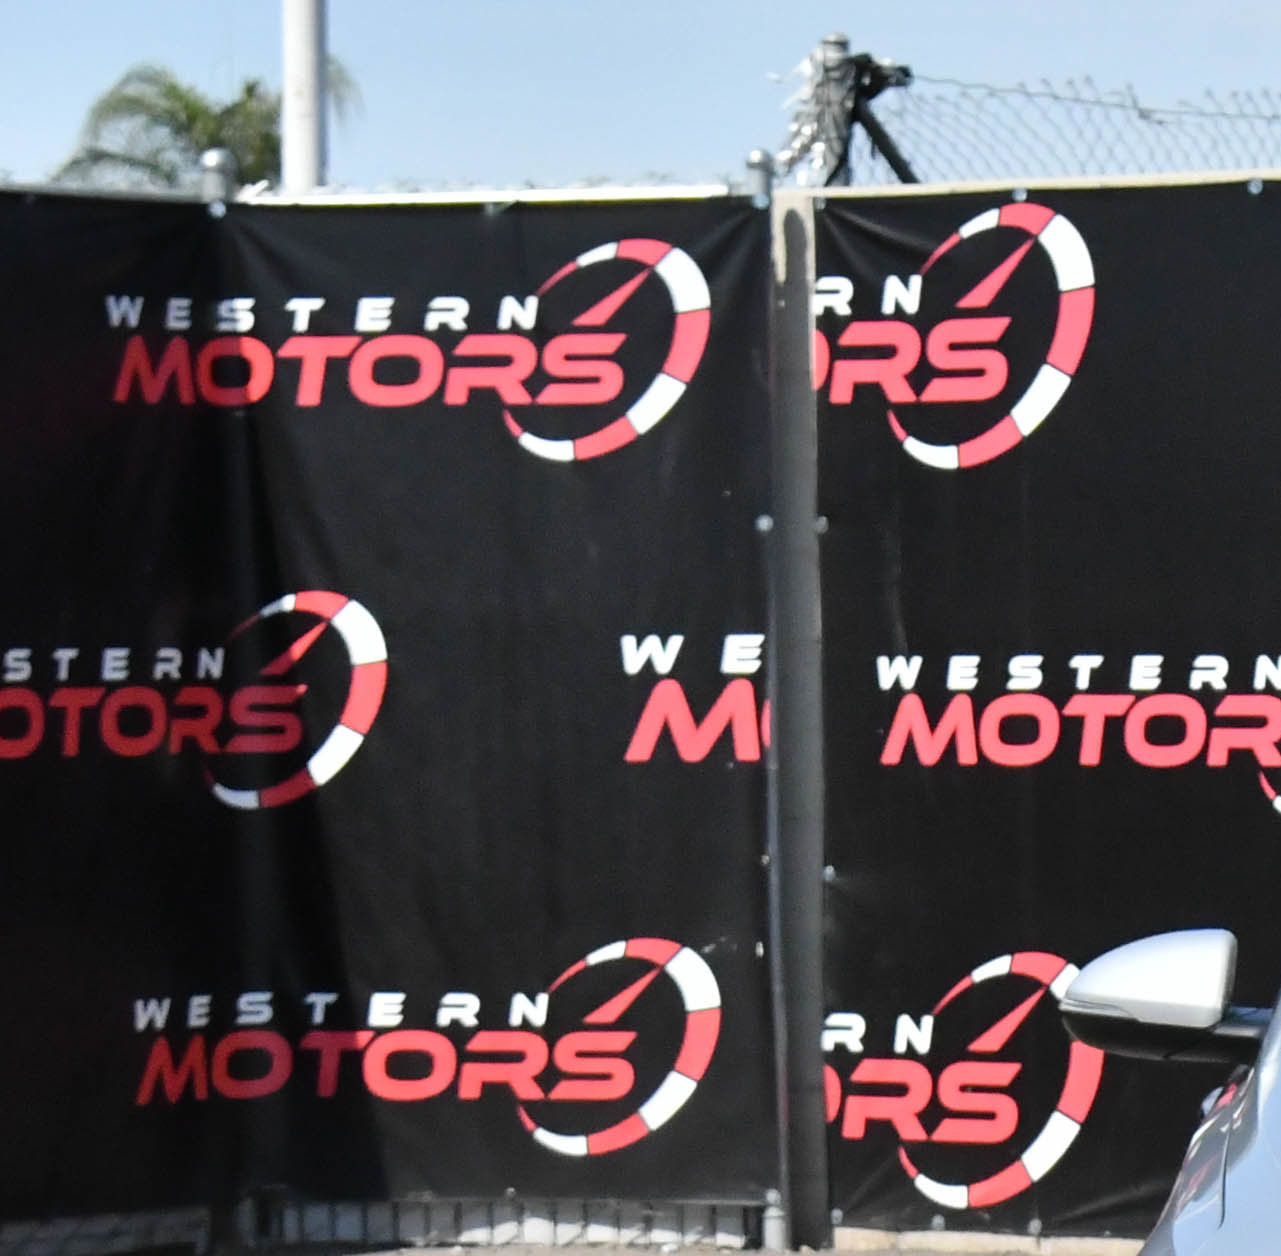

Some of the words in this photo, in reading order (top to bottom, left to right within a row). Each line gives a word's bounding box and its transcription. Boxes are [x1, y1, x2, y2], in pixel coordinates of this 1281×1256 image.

[107, 294, 540, 333] WESTERN
[113, 331, 628, 408] MOTORS
[811, 316, 1013, 405] RS
[3, 648, 224, 682] STERN
[620, 633, 766, 676] WE
[623, 677, 771, 764] M
[135, 990, 549, 1031] WESTERN
[136, 1027, 638, 1106] MOTORS
[822, 1056, 1024, 1145] RS
